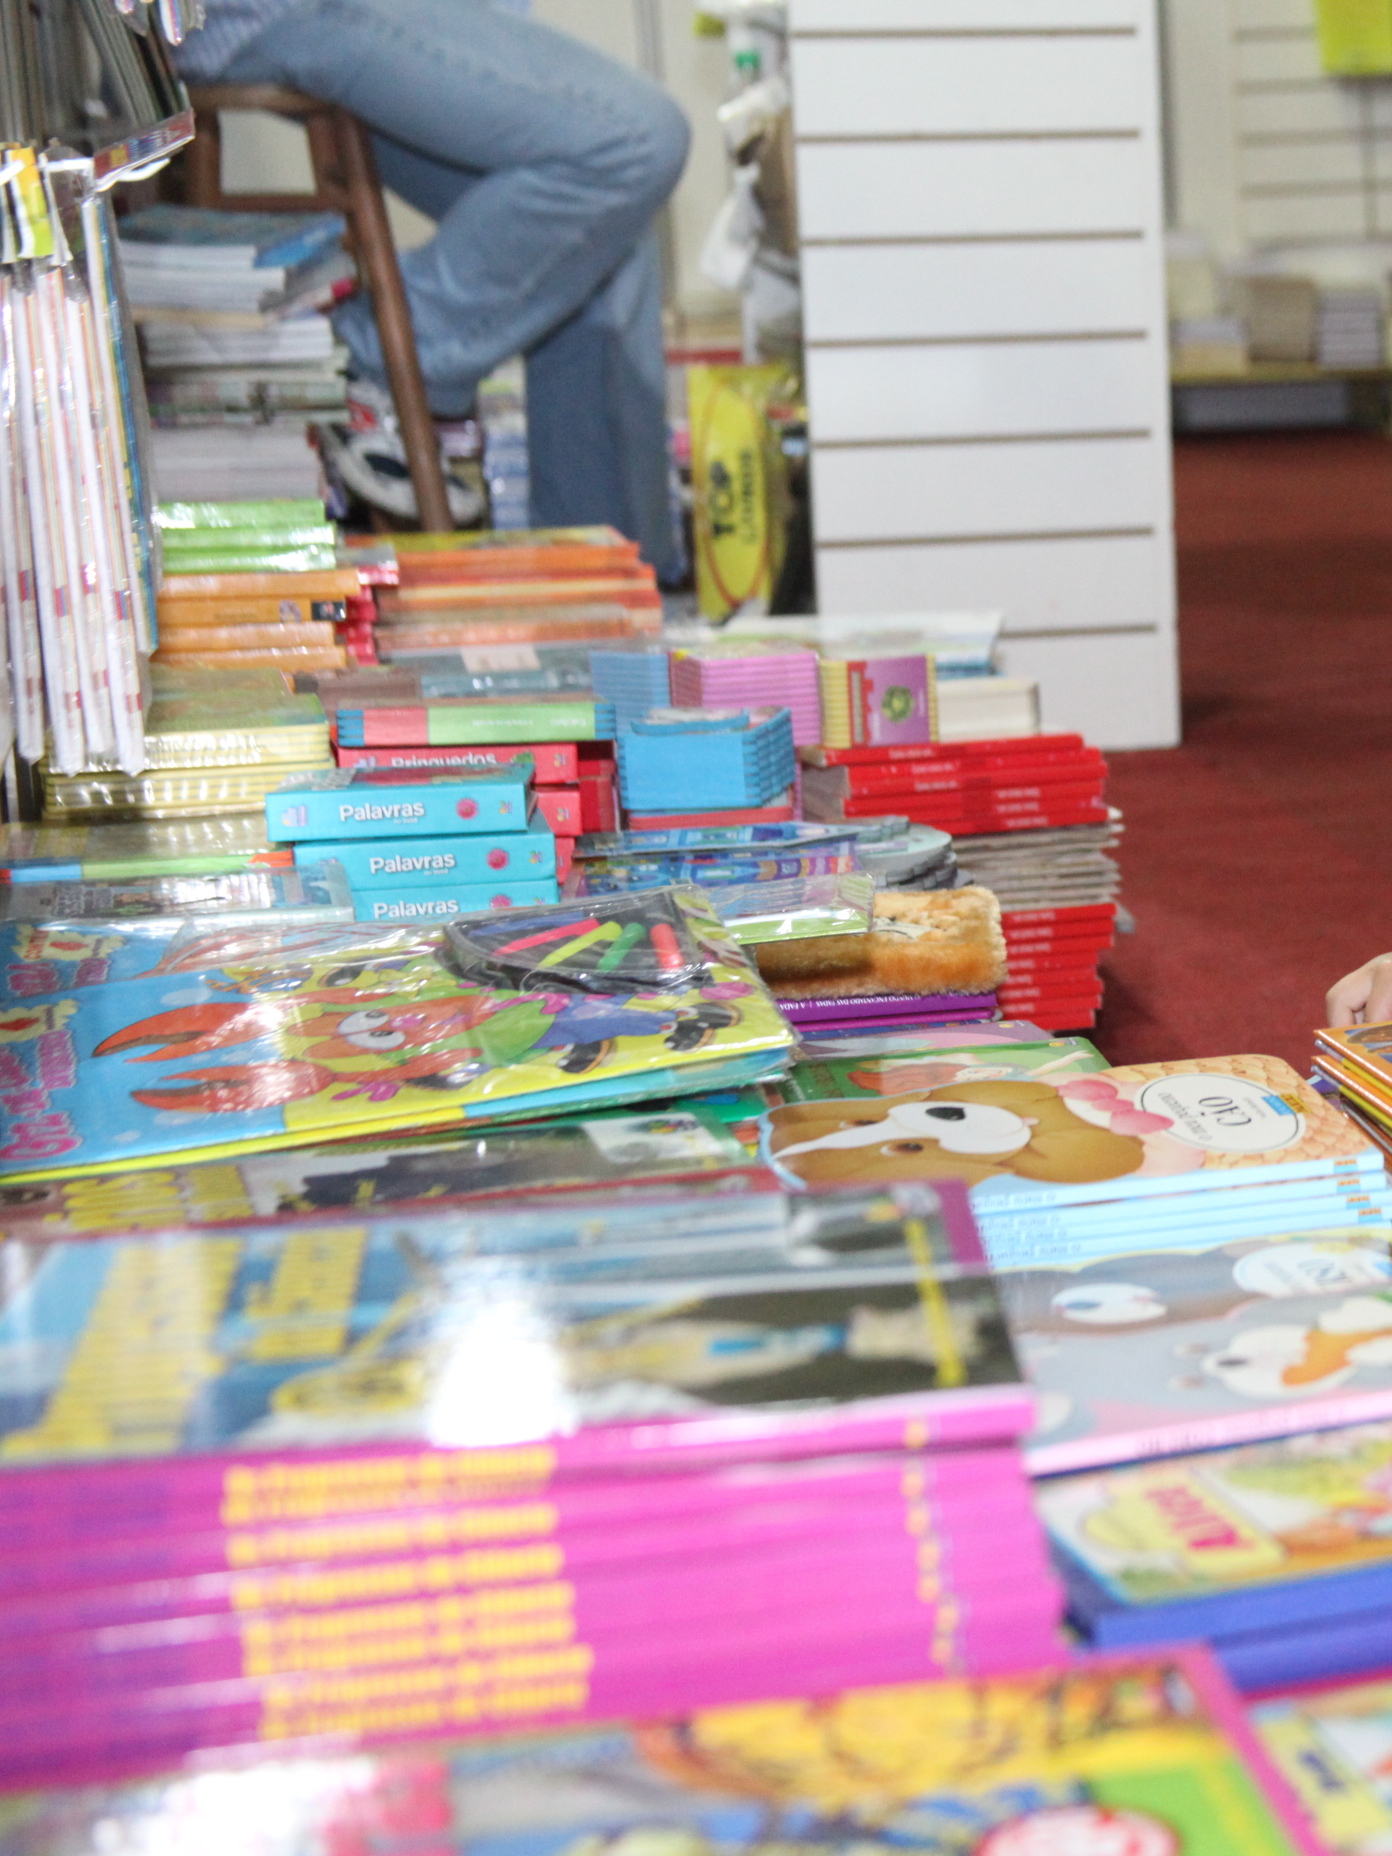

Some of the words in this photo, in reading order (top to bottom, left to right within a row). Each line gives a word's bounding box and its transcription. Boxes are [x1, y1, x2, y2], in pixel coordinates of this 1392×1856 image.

[338, 801, 426, 823] Palavras
[369, 852, 456, 875] Palavras
[373, 897, 459, 920] Palavras
